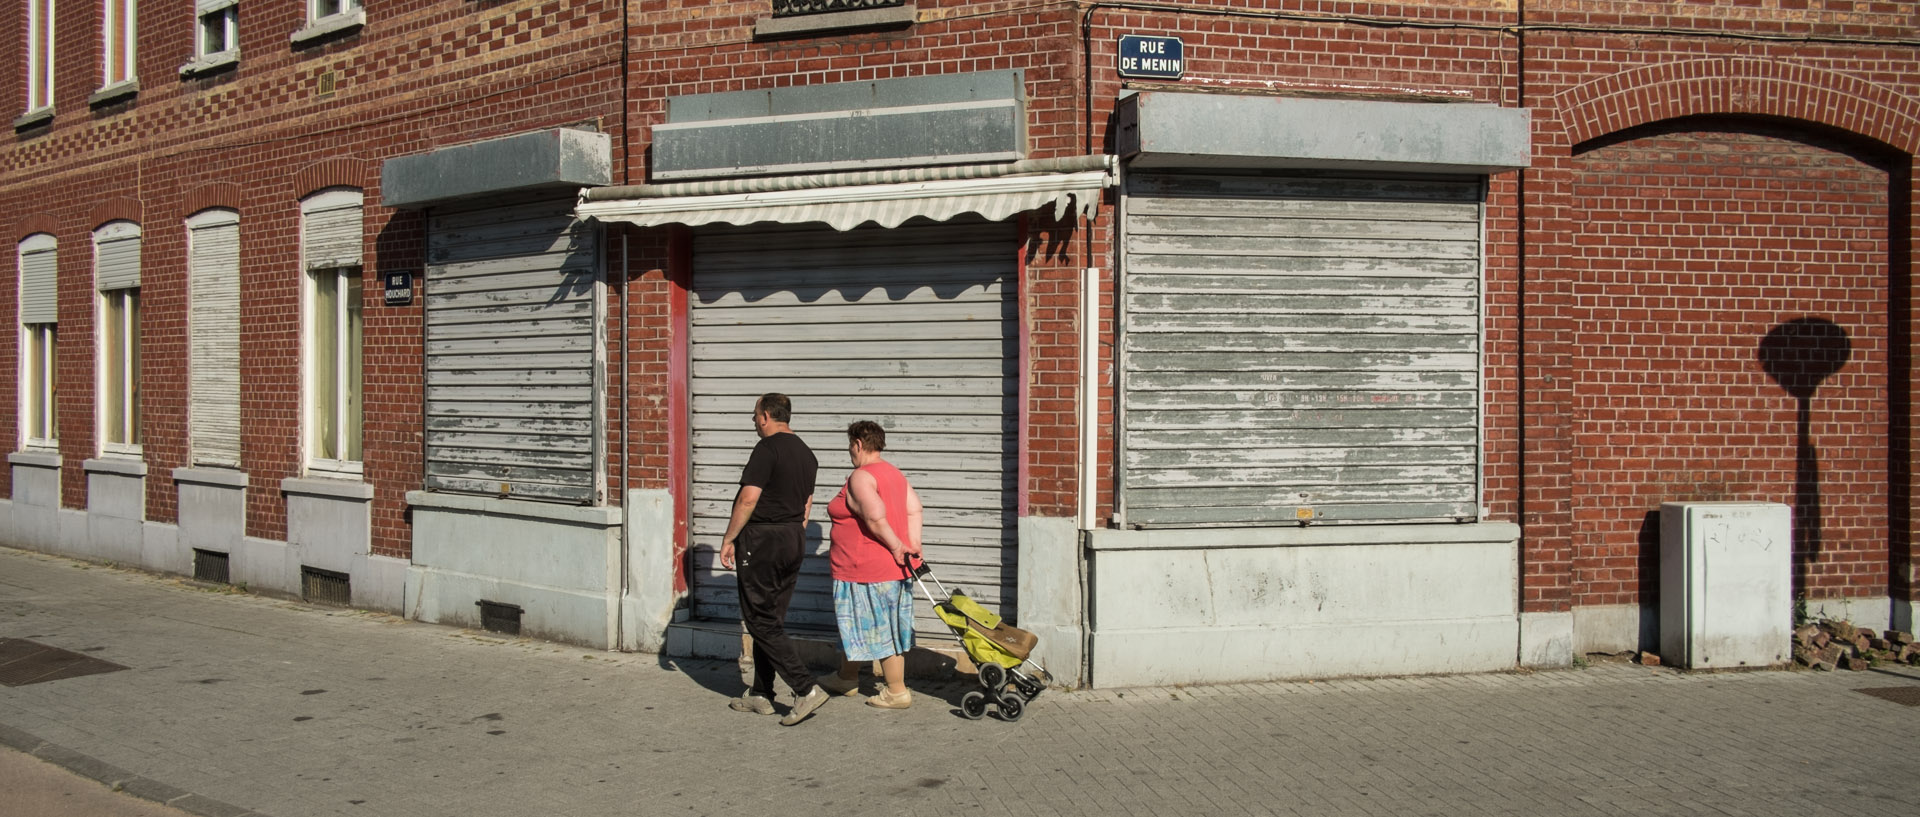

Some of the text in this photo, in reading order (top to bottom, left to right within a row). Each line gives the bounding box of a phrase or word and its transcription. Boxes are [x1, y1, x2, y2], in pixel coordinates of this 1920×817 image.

[1139, 40, 1165, 54] RUE
[1122, 57, 1180, 72] DE MENIN
[392, 276, 402, 286] RUE
